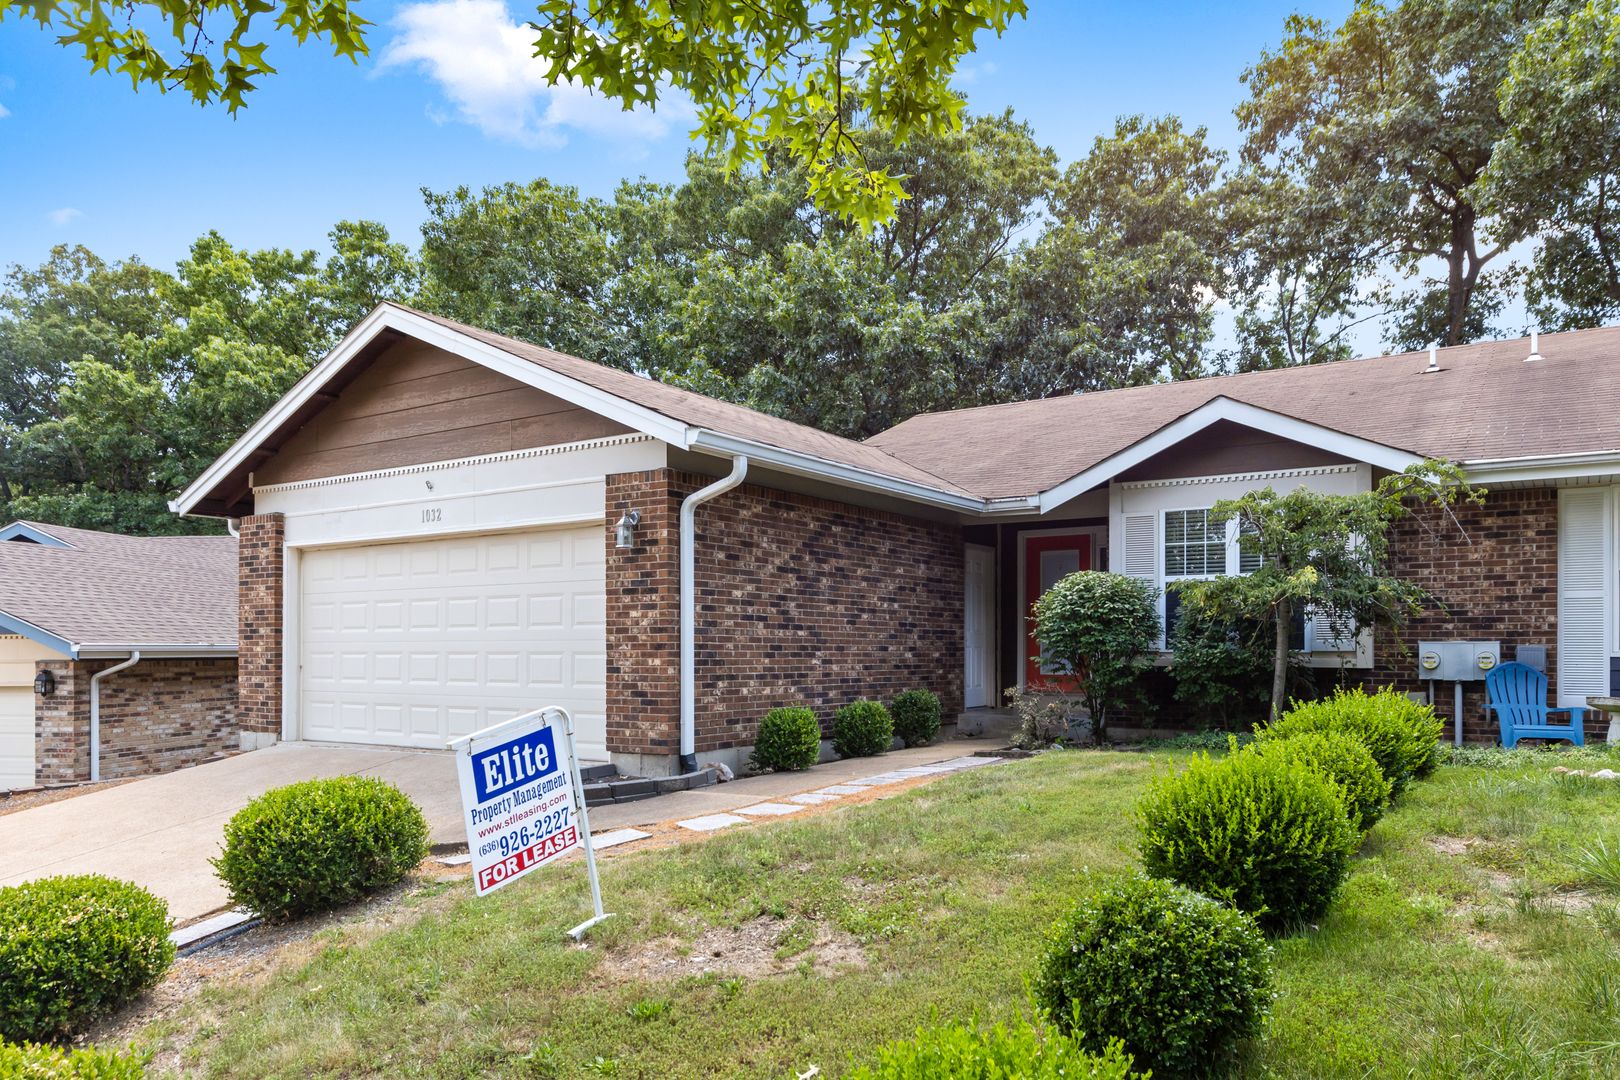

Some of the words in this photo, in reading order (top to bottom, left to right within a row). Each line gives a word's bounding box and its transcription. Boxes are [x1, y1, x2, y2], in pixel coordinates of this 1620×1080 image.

[422, 508, 442, 523] 1032
[481, 743, 549, 794] Elite
[471, 795, 512, 826] Property
[512, 771, 567, 808] Management
[478, 792, 567, 838] www.stlleasing.com
[500, 806, 569, 857] 926-2227
[481, 857, 519, 889] FOR
[522, 829, 575, 864] LEASE
